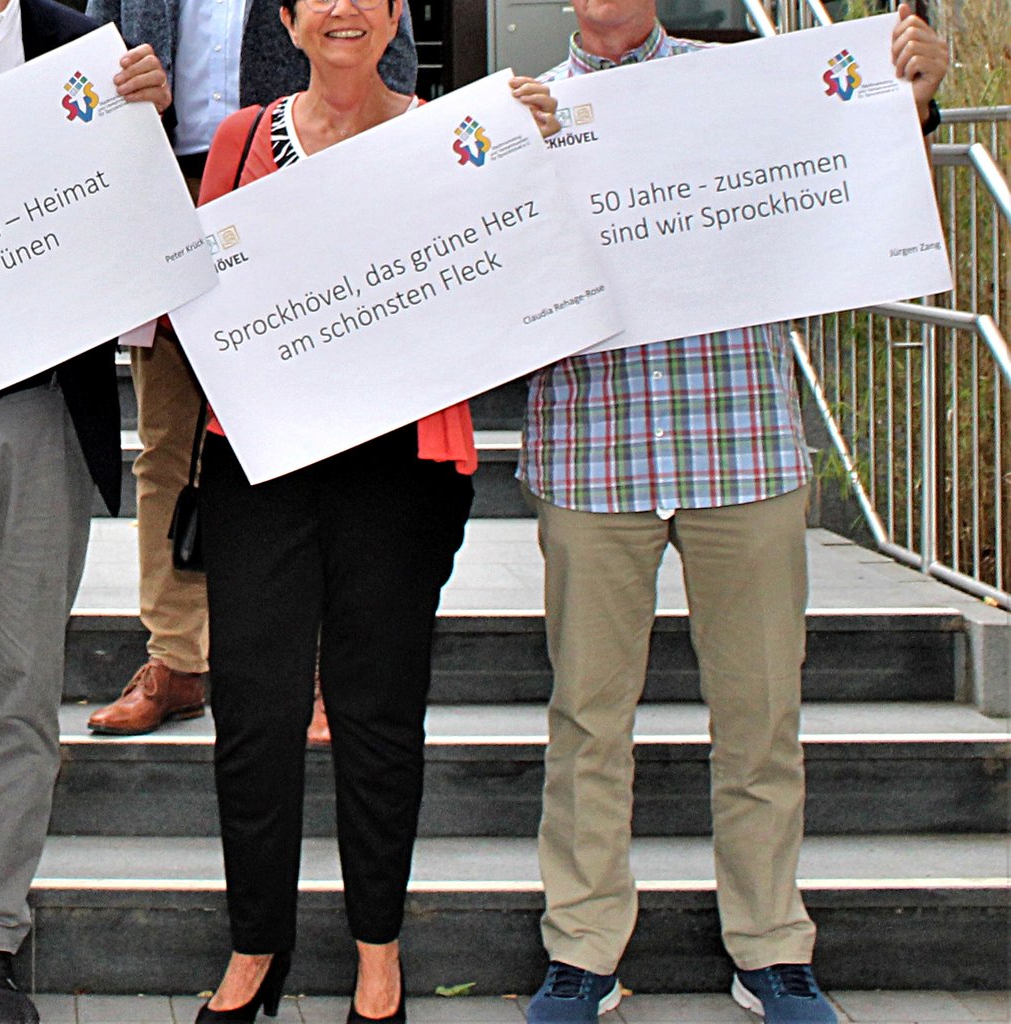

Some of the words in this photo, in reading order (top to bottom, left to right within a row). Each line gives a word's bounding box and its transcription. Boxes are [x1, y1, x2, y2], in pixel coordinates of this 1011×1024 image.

[23, 170, 110, 222] Heimat
[589, 190, 620, 215] 50
[628, 181, 691, 209] Jahre
[714, 153, 848, 192] zusammen
[600, 218, 649, 246] sind
[656, 212, 693, 236] wir
[700, 180, 850, 230] Sprockhövel
[165, 248, 186, 264] Peter
[213, 275, 362, 352] Sprockhövel,
[365, 257, 406, 287] das
[410, 227, 479, 272] grüne
[481, 200, 539, 236] Herz
[277, 334, 315, 361] am
[319, 280, 437, 344] schönsten
[439, 250, 503, 292] Fleck
[522, 308, 554, 326] Claudia
